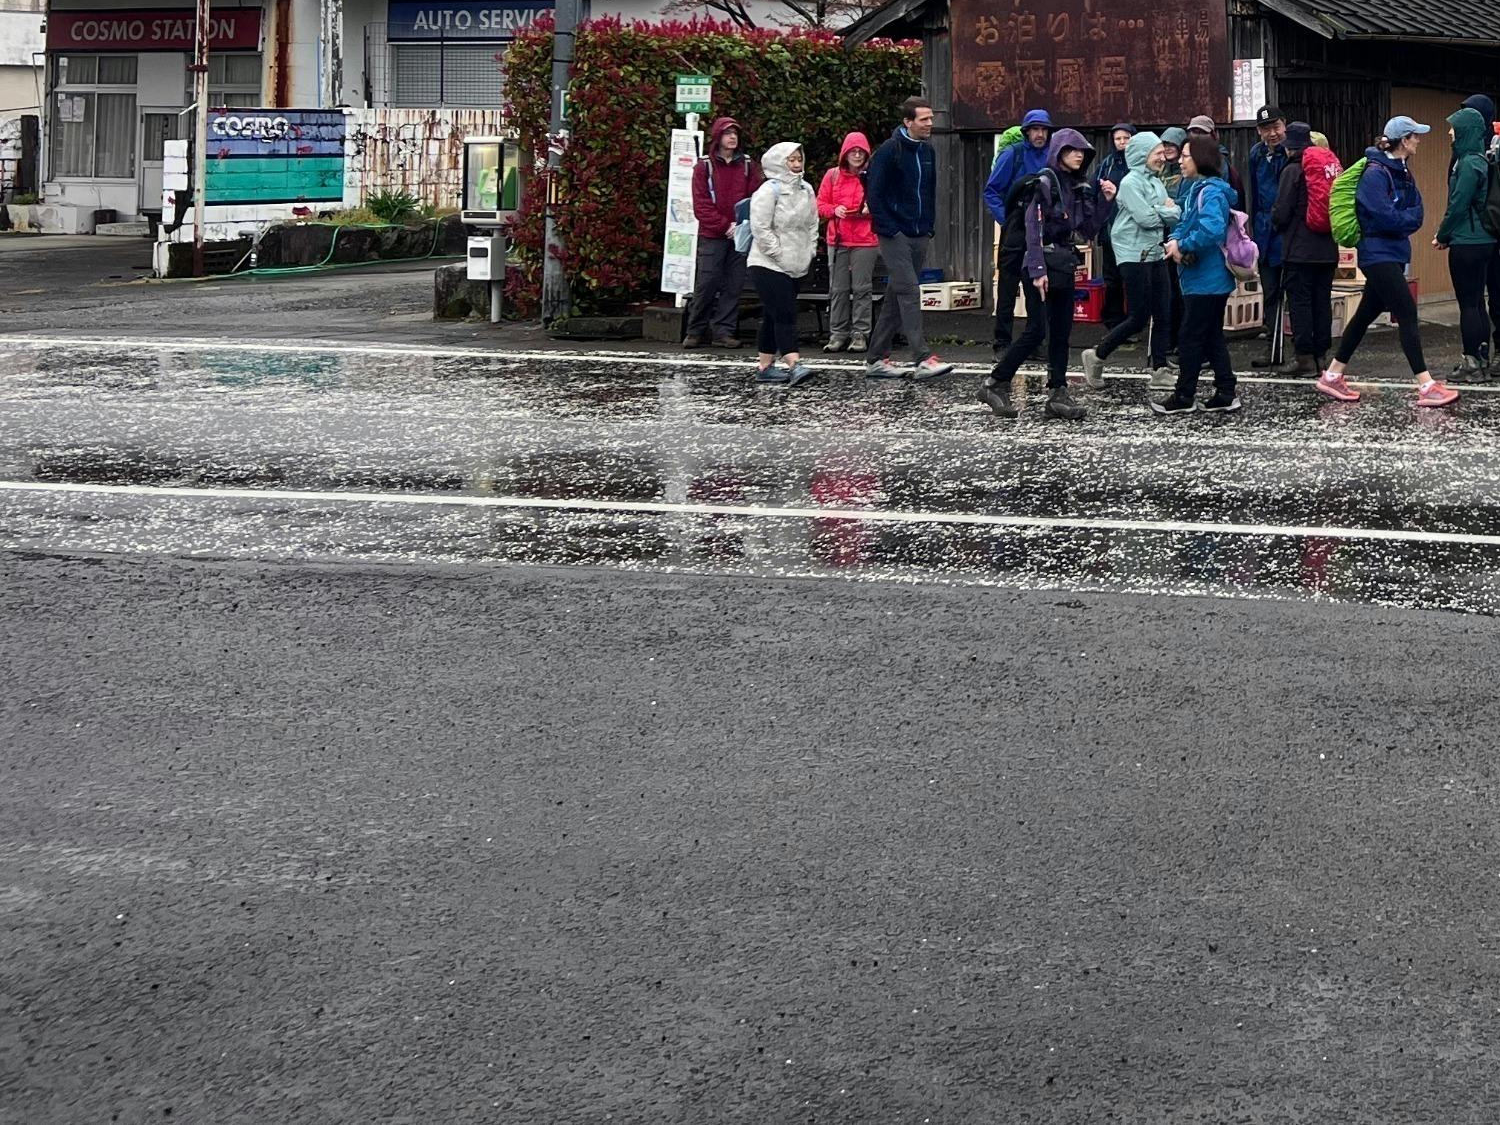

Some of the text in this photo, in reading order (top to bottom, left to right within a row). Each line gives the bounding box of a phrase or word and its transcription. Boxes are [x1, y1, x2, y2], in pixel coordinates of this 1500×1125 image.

[70, 18, 236, 41] COSMO STATON
[413, 8, 556, 31] AUTO SERVI
